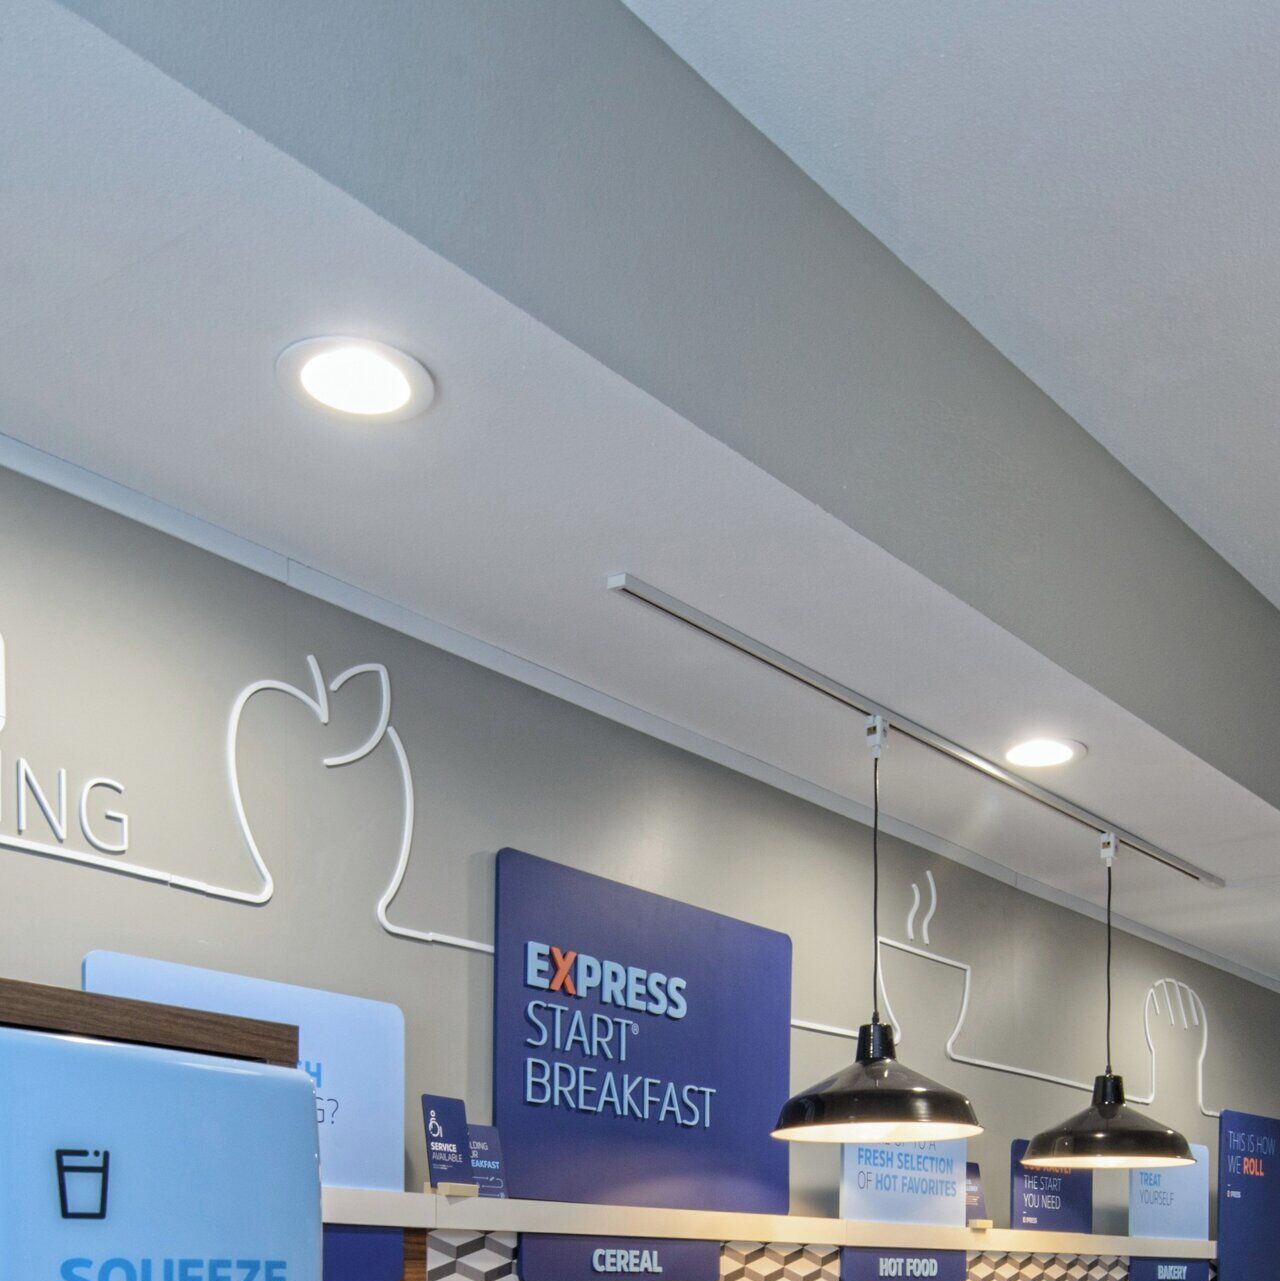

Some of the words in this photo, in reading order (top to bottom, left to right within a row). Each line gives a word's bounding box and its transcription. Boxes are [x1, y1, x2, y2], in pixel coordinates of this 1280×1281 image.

[526, 940, 687, 1019] EXPRESS
[525, 1057, 716, 1129] BREAKFAST
[431, 1142, 457, 1152] SERVICE
[469, 1141, 489, 1151] LDING
[1228, 1130, 1245, 1151] THIS
[1247, 1134, 1255, 1153] IS
[1257, 1136, 1276, 1155] HOW
[432, 1152, 463, 1162] AVAILABLE
[471, 1160, 500, 1169] EAKFAST
[857, 1148, 893, 1168] FRESH
[897, 1152, 953, 1174] SELECTION
[1227, 1155, 1241, 1175] WE
[1243, 1156, 1264, 1176] ROLL
[858, 1170, 872, 1190] OF
[875, 1173, 898, 1192] HOT
[901, 1176, 956, 1197] FAVORITES
[1024, 1175, 1038, 1189] THE
[1040, 1176, 1061, 1191] START
[1139, 1172, 1161, 1187] TREAT
[1023, 1193, 1040, 1208] YOU
[1041, 1195, 1061, 1209] NEED
[1139, 1189, 1174, 1206] YOURSELF
[592, 1248, 663, 1275] CEREAL
[879, 1257, 903, 1277] HOT
[906, 1258, 938, 1277] FOOD
[1158, 1265, 1187, 1280] BAKERY
